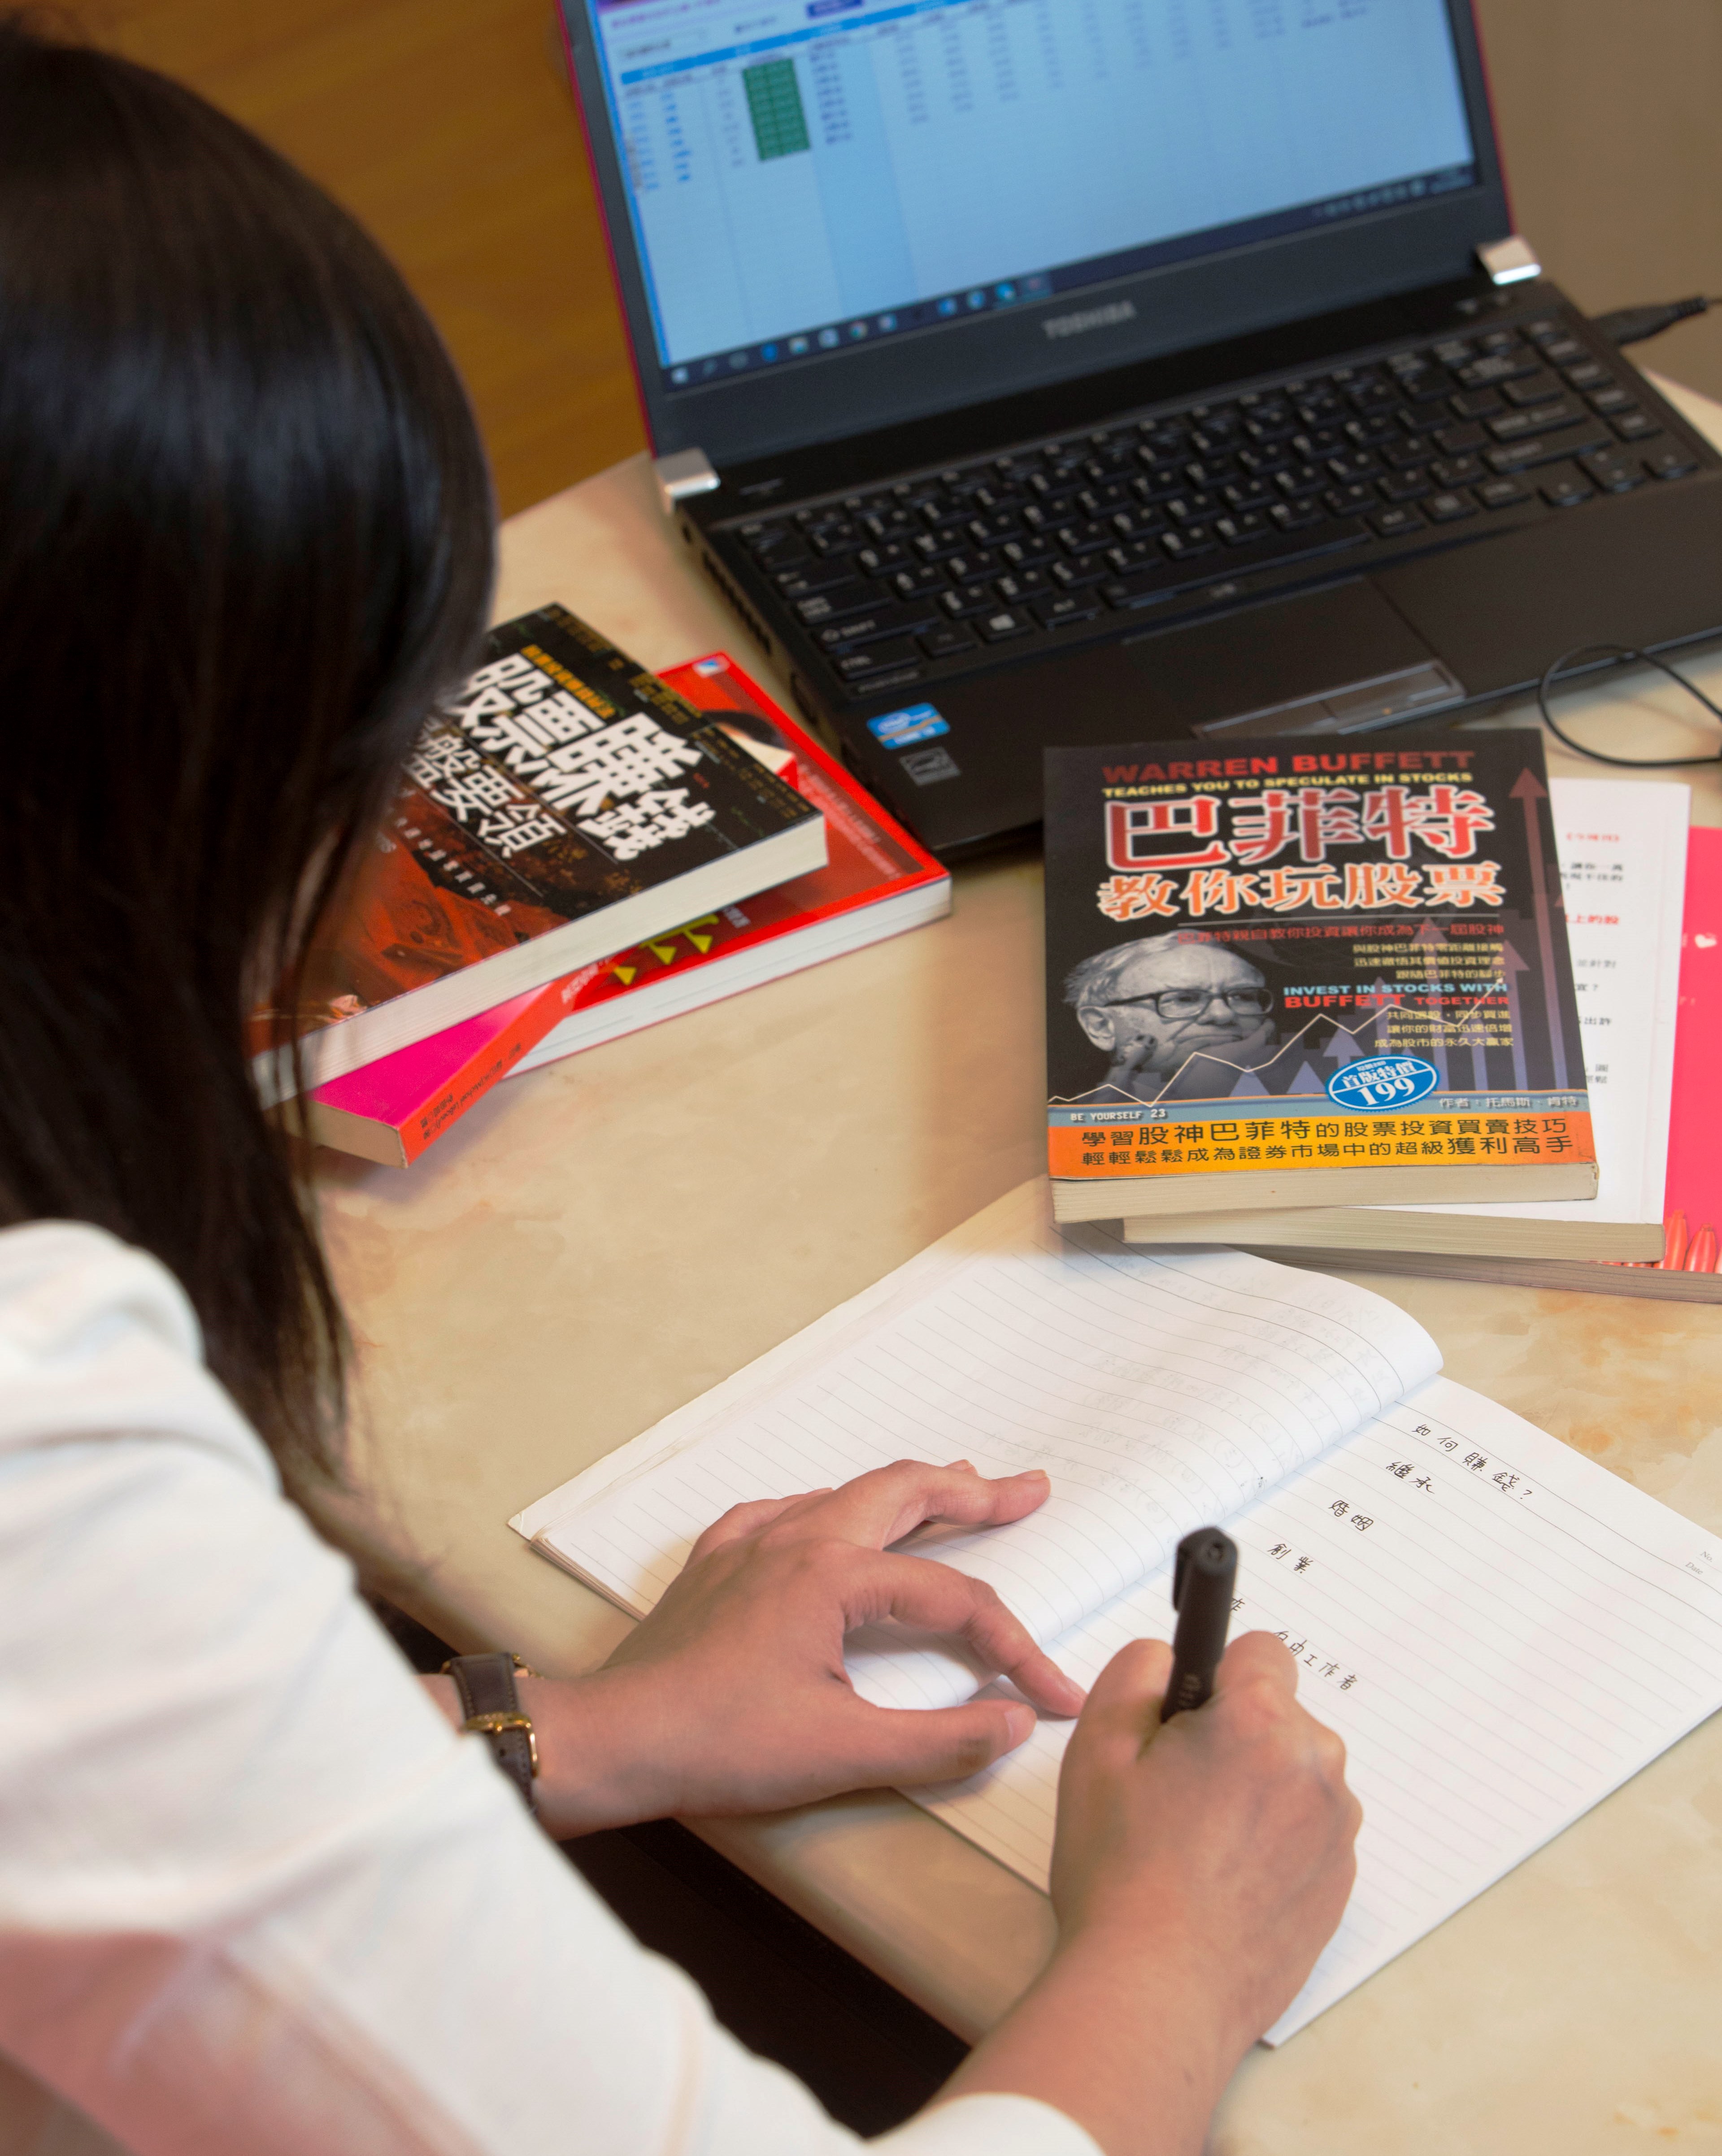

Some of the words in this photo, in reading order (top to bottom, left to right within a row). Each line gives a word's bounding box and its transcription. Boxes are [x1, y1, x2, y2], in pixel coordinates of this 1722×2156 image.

[1102, 756, 1278, 784] WARREN
[1292, 751, 1474, 773] BUFFETT
[1102, 783, 1187, 798] TEACHES
[1191, 780, 1231, 792] YOU
[1234, 779, 1260, 789] TO
[1264, 774, 1370, 788] SPECULATE
[1374, 774, 1395, 784] IN
[1398, 772, 1473, 784] STOCKS
[1105, 784, 1496, 873] 巴菲特
[1096, 861, 1507, 923] 教你玩股票
[1283, 985, 1351, 996] INVEST
[1356, 985, 1376, 994] IN
[1381, 983, 1456, 993] STOCKS
[1459, 982, 1508, 992] WITH
[1284, 994, 1405, 1009] BUFFETT
[1414, 996, 1509, 1005] TOGETHER
[1357, 1077, 1415, 1107] 199
[1070, 1112, 1083, 1121] BE
[1091, 1110, 1142, 1121] YOURSELF
[1150, 1108, 1167, 1119] 23
[1082, 1118, 1566, 1147] 學習股神巴菲特的股票投資買賣技巧
[1082, 1135, 1574, 1166] 輕輕鬆鬆成為證券市場中的超級獲利高手
[1267, 1543, 1314, 1574] 創業
[1685, 1561, 1704, 1575] Date
[1700, 1551, 1713, 1563] No.
